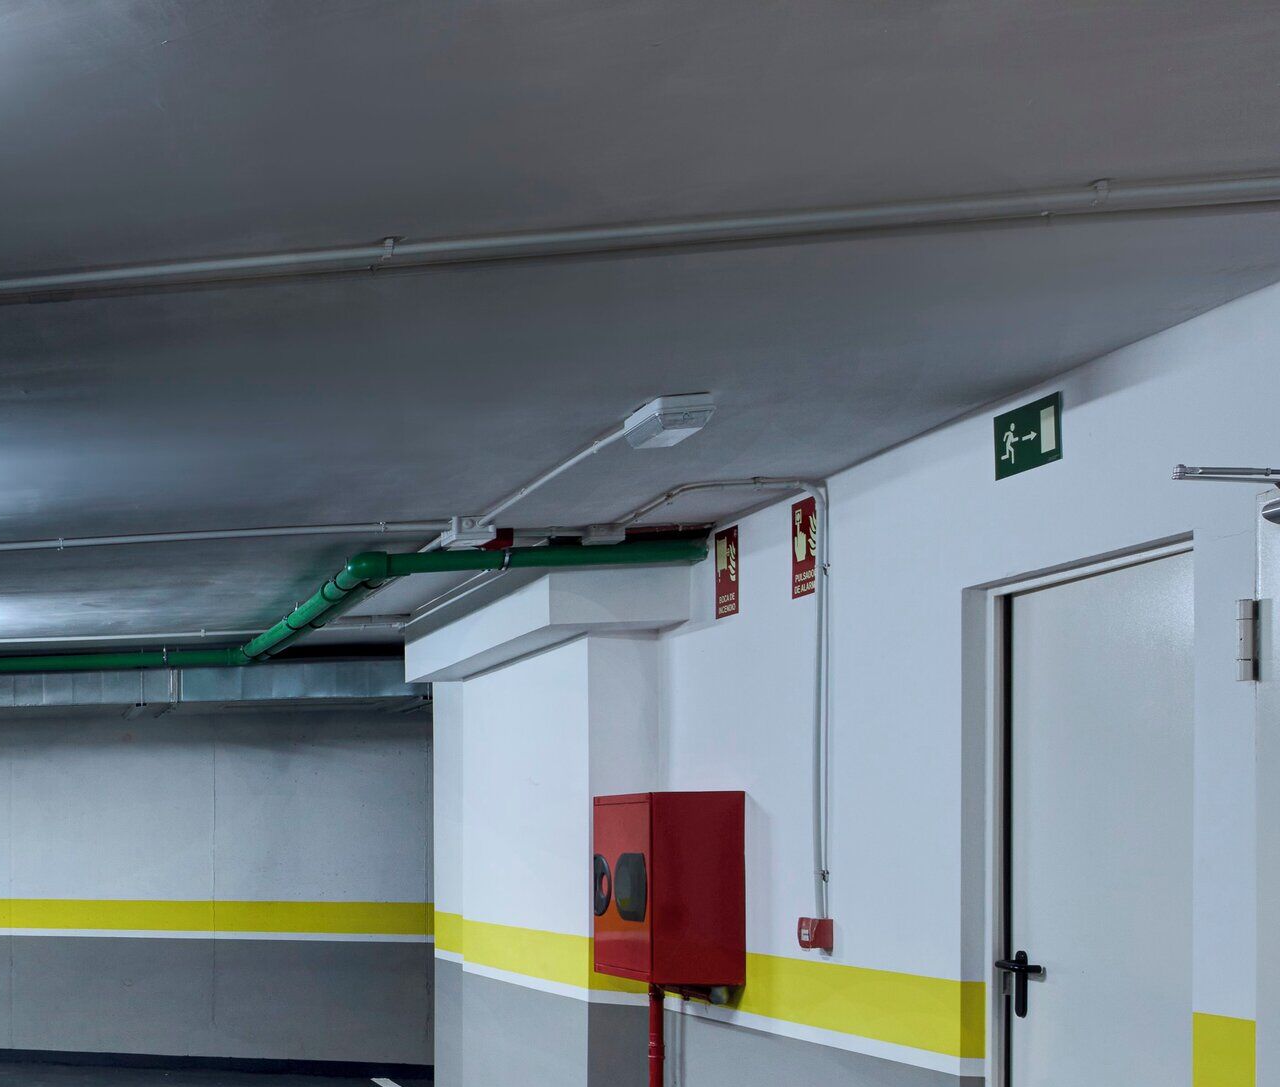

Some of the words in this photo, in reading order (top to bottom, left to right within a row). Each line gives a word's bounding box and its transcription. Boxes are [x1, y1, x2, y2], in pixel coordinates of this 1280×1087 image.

[795, 569, 816, 583] PULSADO
[794, 585, 801, 594] DE
[801, 581, 816, 592] ALARM
[729, 592, 735, 601] DE
